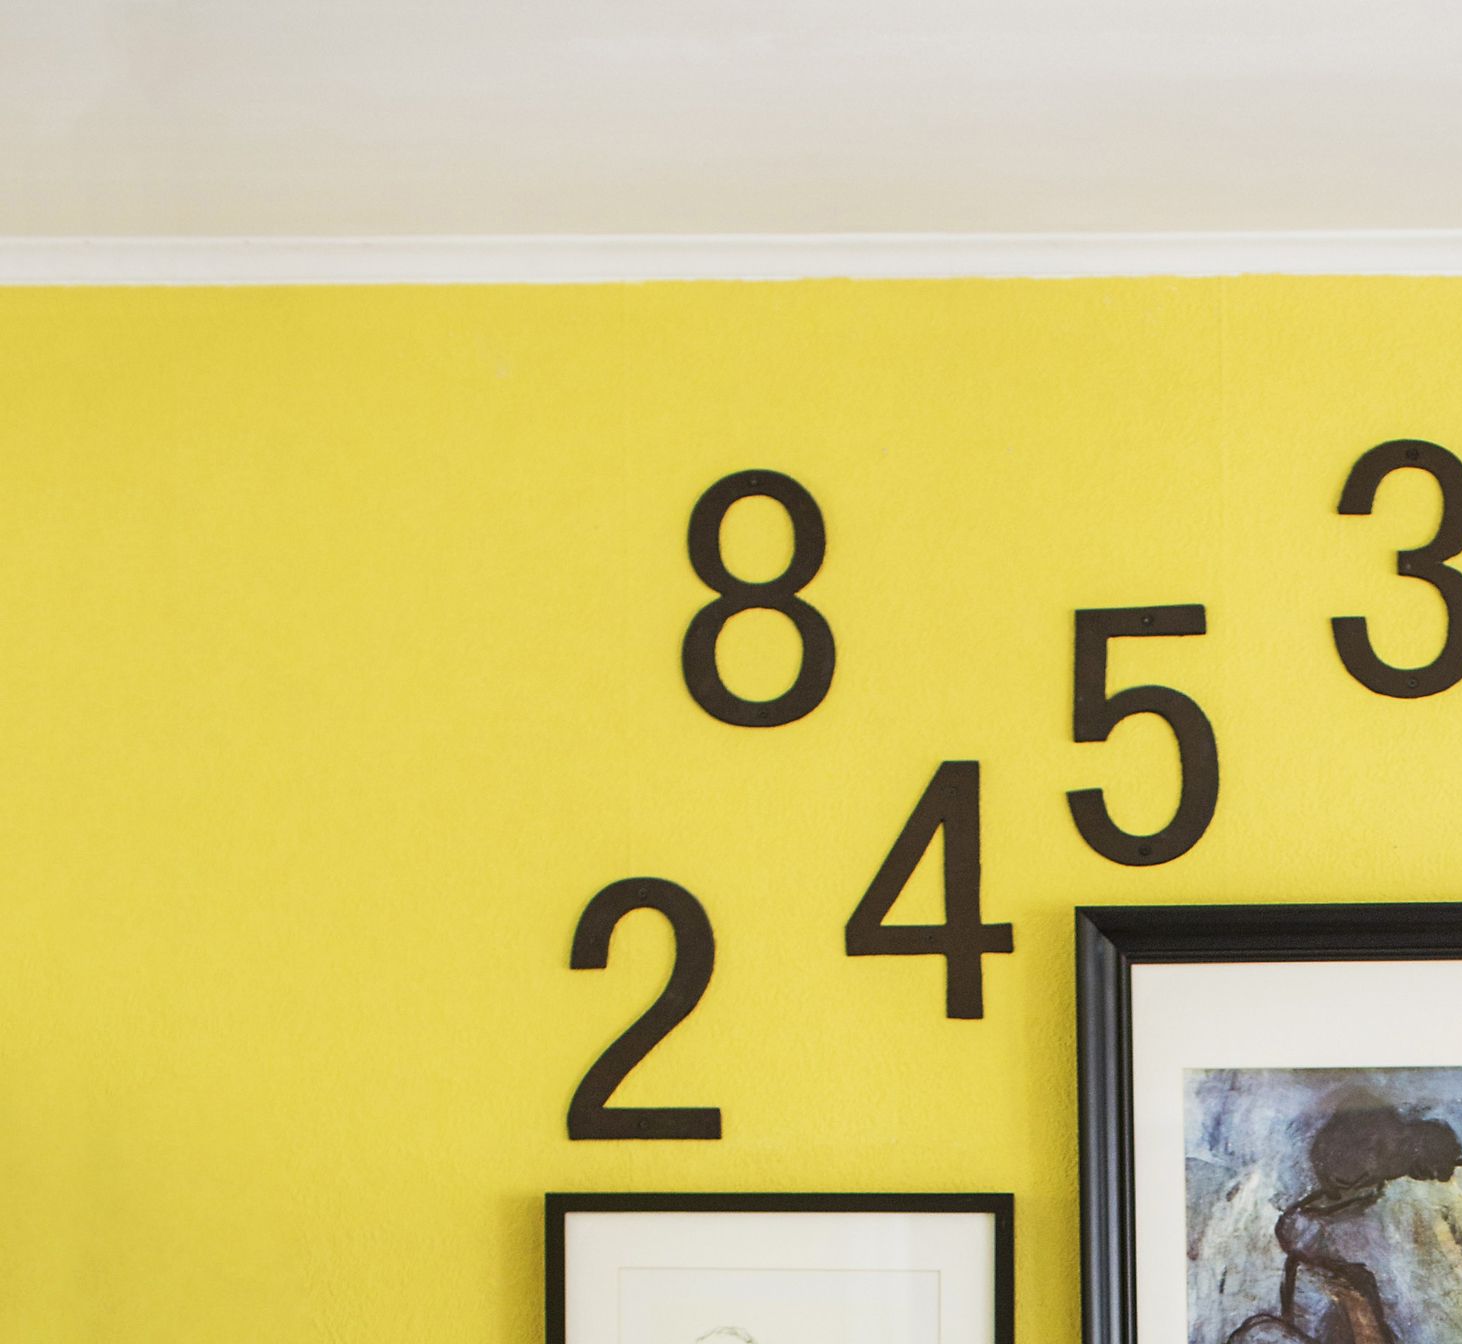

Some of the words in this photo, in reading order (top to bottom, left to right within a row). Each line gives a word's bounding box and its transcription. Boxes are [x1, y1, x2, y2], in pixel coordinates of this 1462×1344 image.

[682, 469, 836, 727] 8
[1067, 604, 1220, 867] 5
[568, 877, 722, 1140] 2
[845, 761, 1014, 1020] 4
